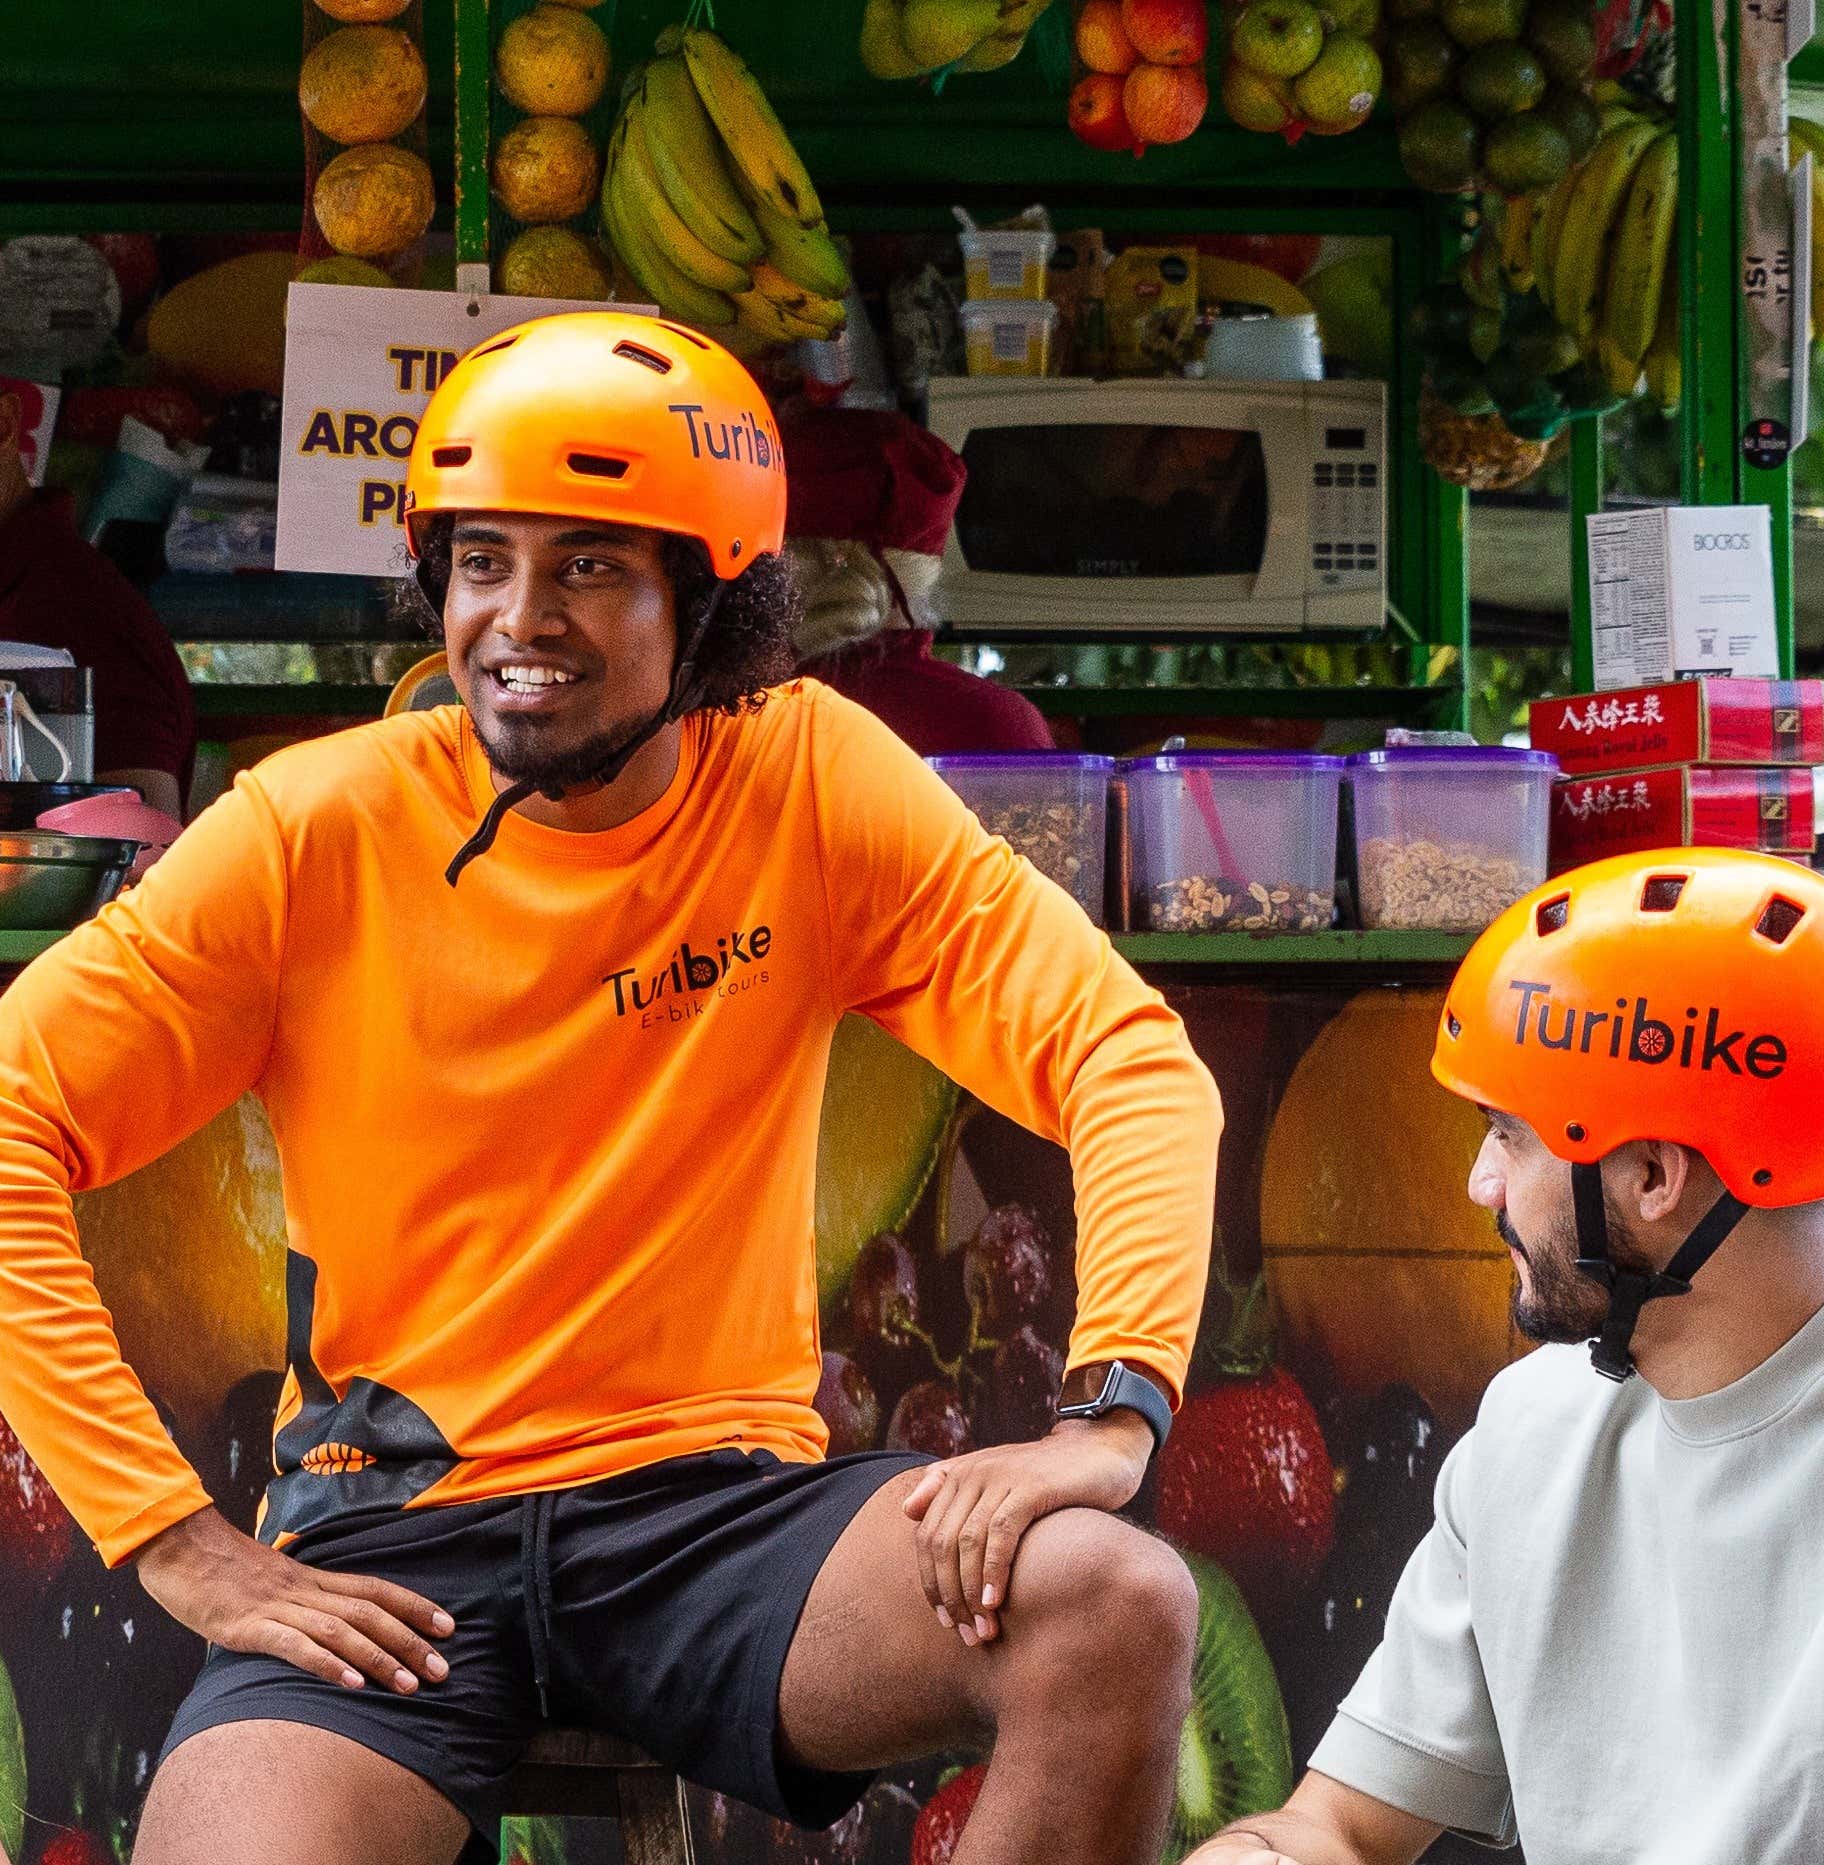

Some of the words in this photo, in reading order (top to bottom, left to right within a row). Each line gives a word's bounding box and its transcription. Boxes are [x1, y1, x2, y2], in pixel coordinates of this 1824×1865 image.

[387, 346, 459, 392] TI
[300, 411, 420, 459] ARO
[667, 404, 787, 477] Turibik
[601, 924, 772, 1017] Turibike
[641, 999, 705, 1030] E-bik
[717, 969, 771, 998] tours
[1509, 979, 1788, 1080] Turibike
